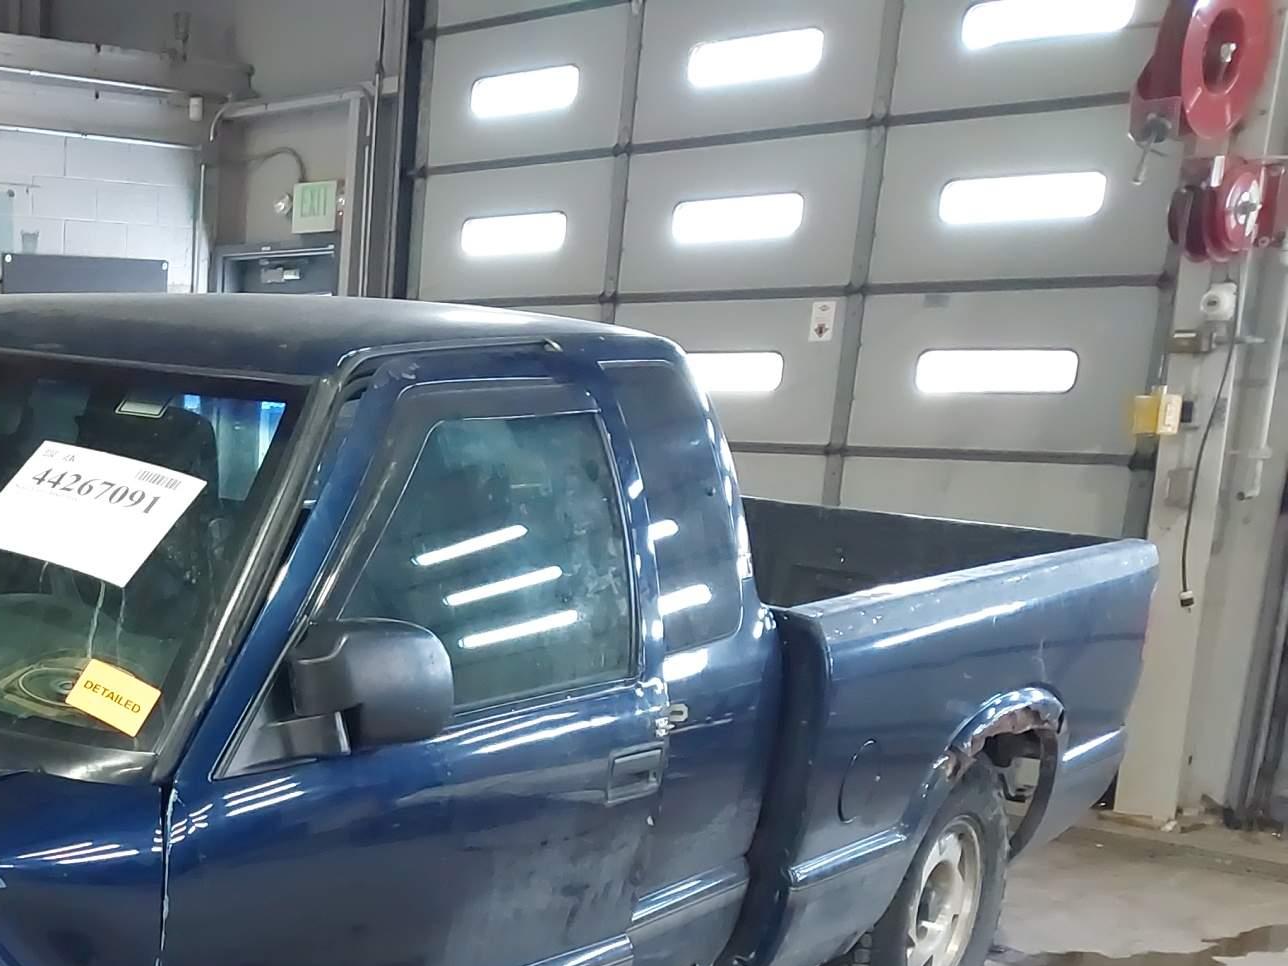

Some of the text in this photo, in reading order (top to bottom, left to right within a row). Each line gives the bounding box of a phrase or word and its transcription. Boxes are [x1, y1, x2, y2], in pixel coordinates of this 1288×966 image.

[300, 186, 328, 218] EXIT
[32, 468, 161, 514] 44267091
[83, 680, 141, 713] DETAILED
